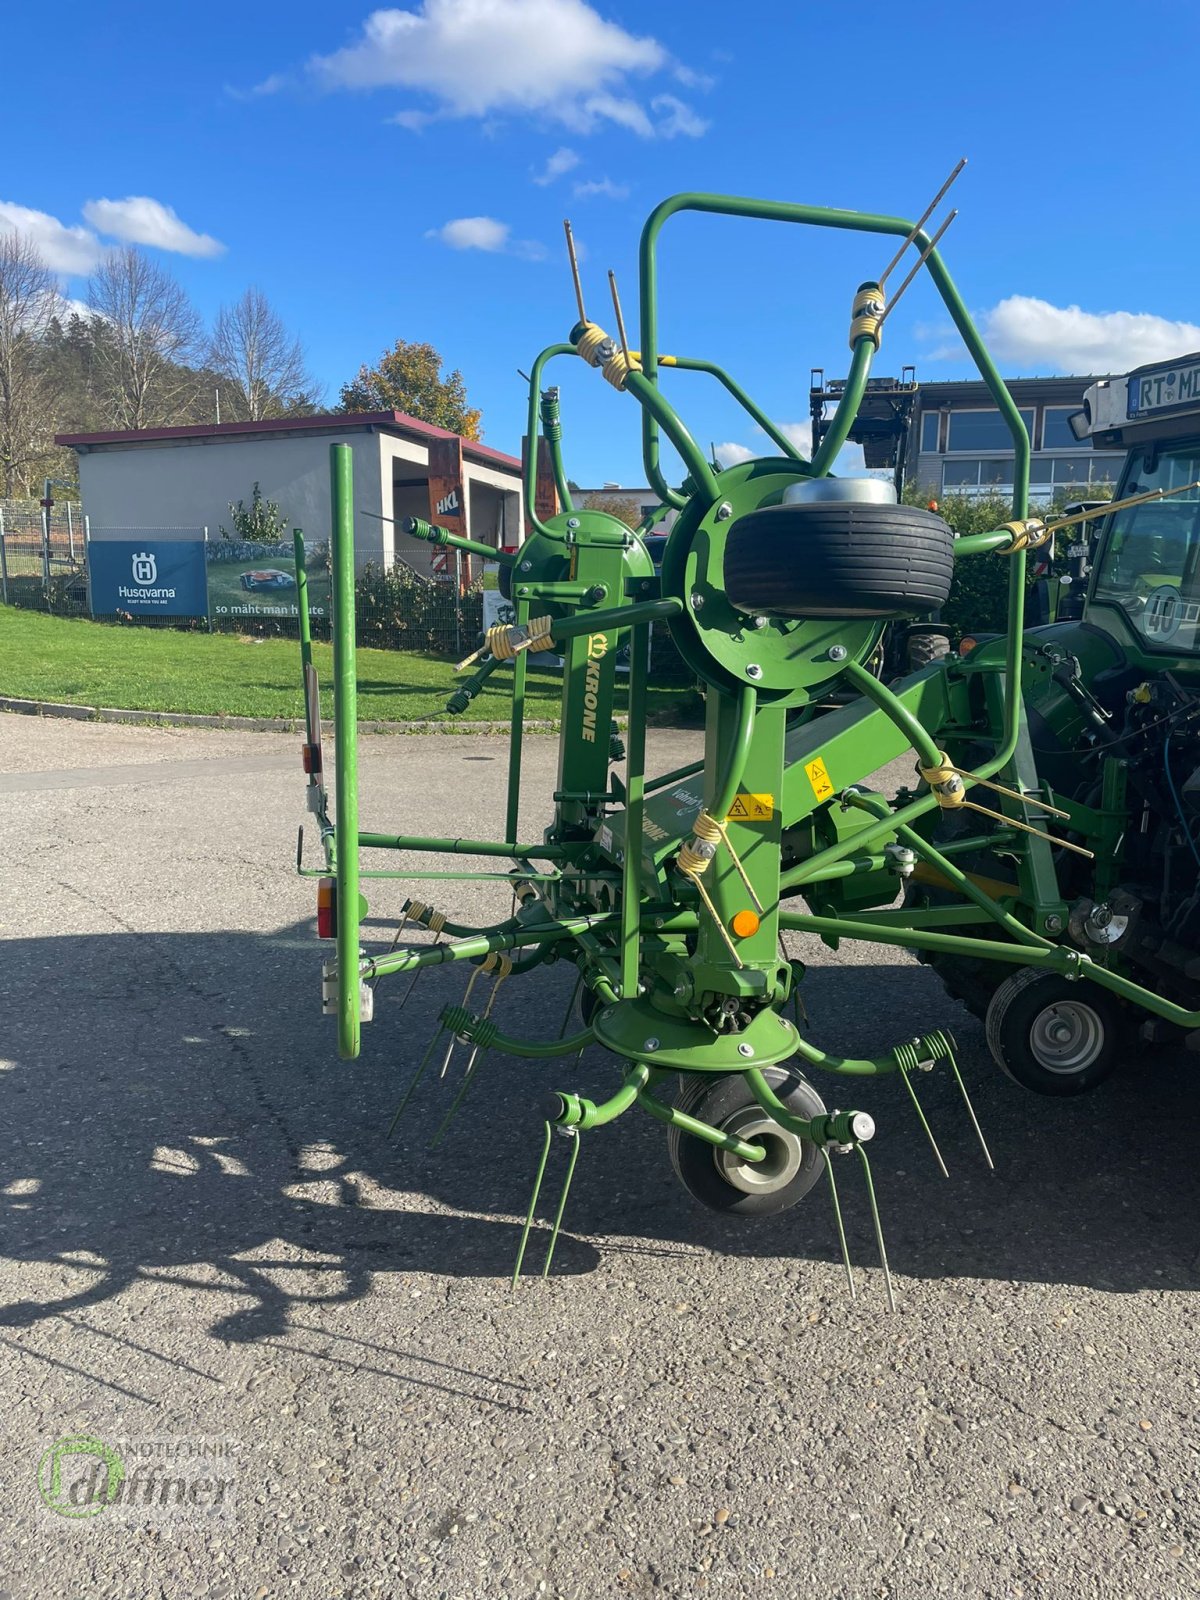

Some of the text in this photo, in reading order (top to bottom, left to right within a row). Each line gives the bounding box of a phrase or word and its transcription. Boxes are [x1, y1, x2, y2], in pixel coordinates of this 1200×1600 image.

[1140, 376, 1165, 407] RT
[436, 490, 459, 515] HKL
[138, 562, 151, 579] H
[118, 586, 175, 599] Husqvarna
[215, 605, 228, 614] so
[231, 603, 260, 614] mäht
[263, 605, 288, 615] man
[1149, 595, 1175, 633] 40
[582, 659, 600, 743] KRONE
[642, 815, 670, 841] RONE
